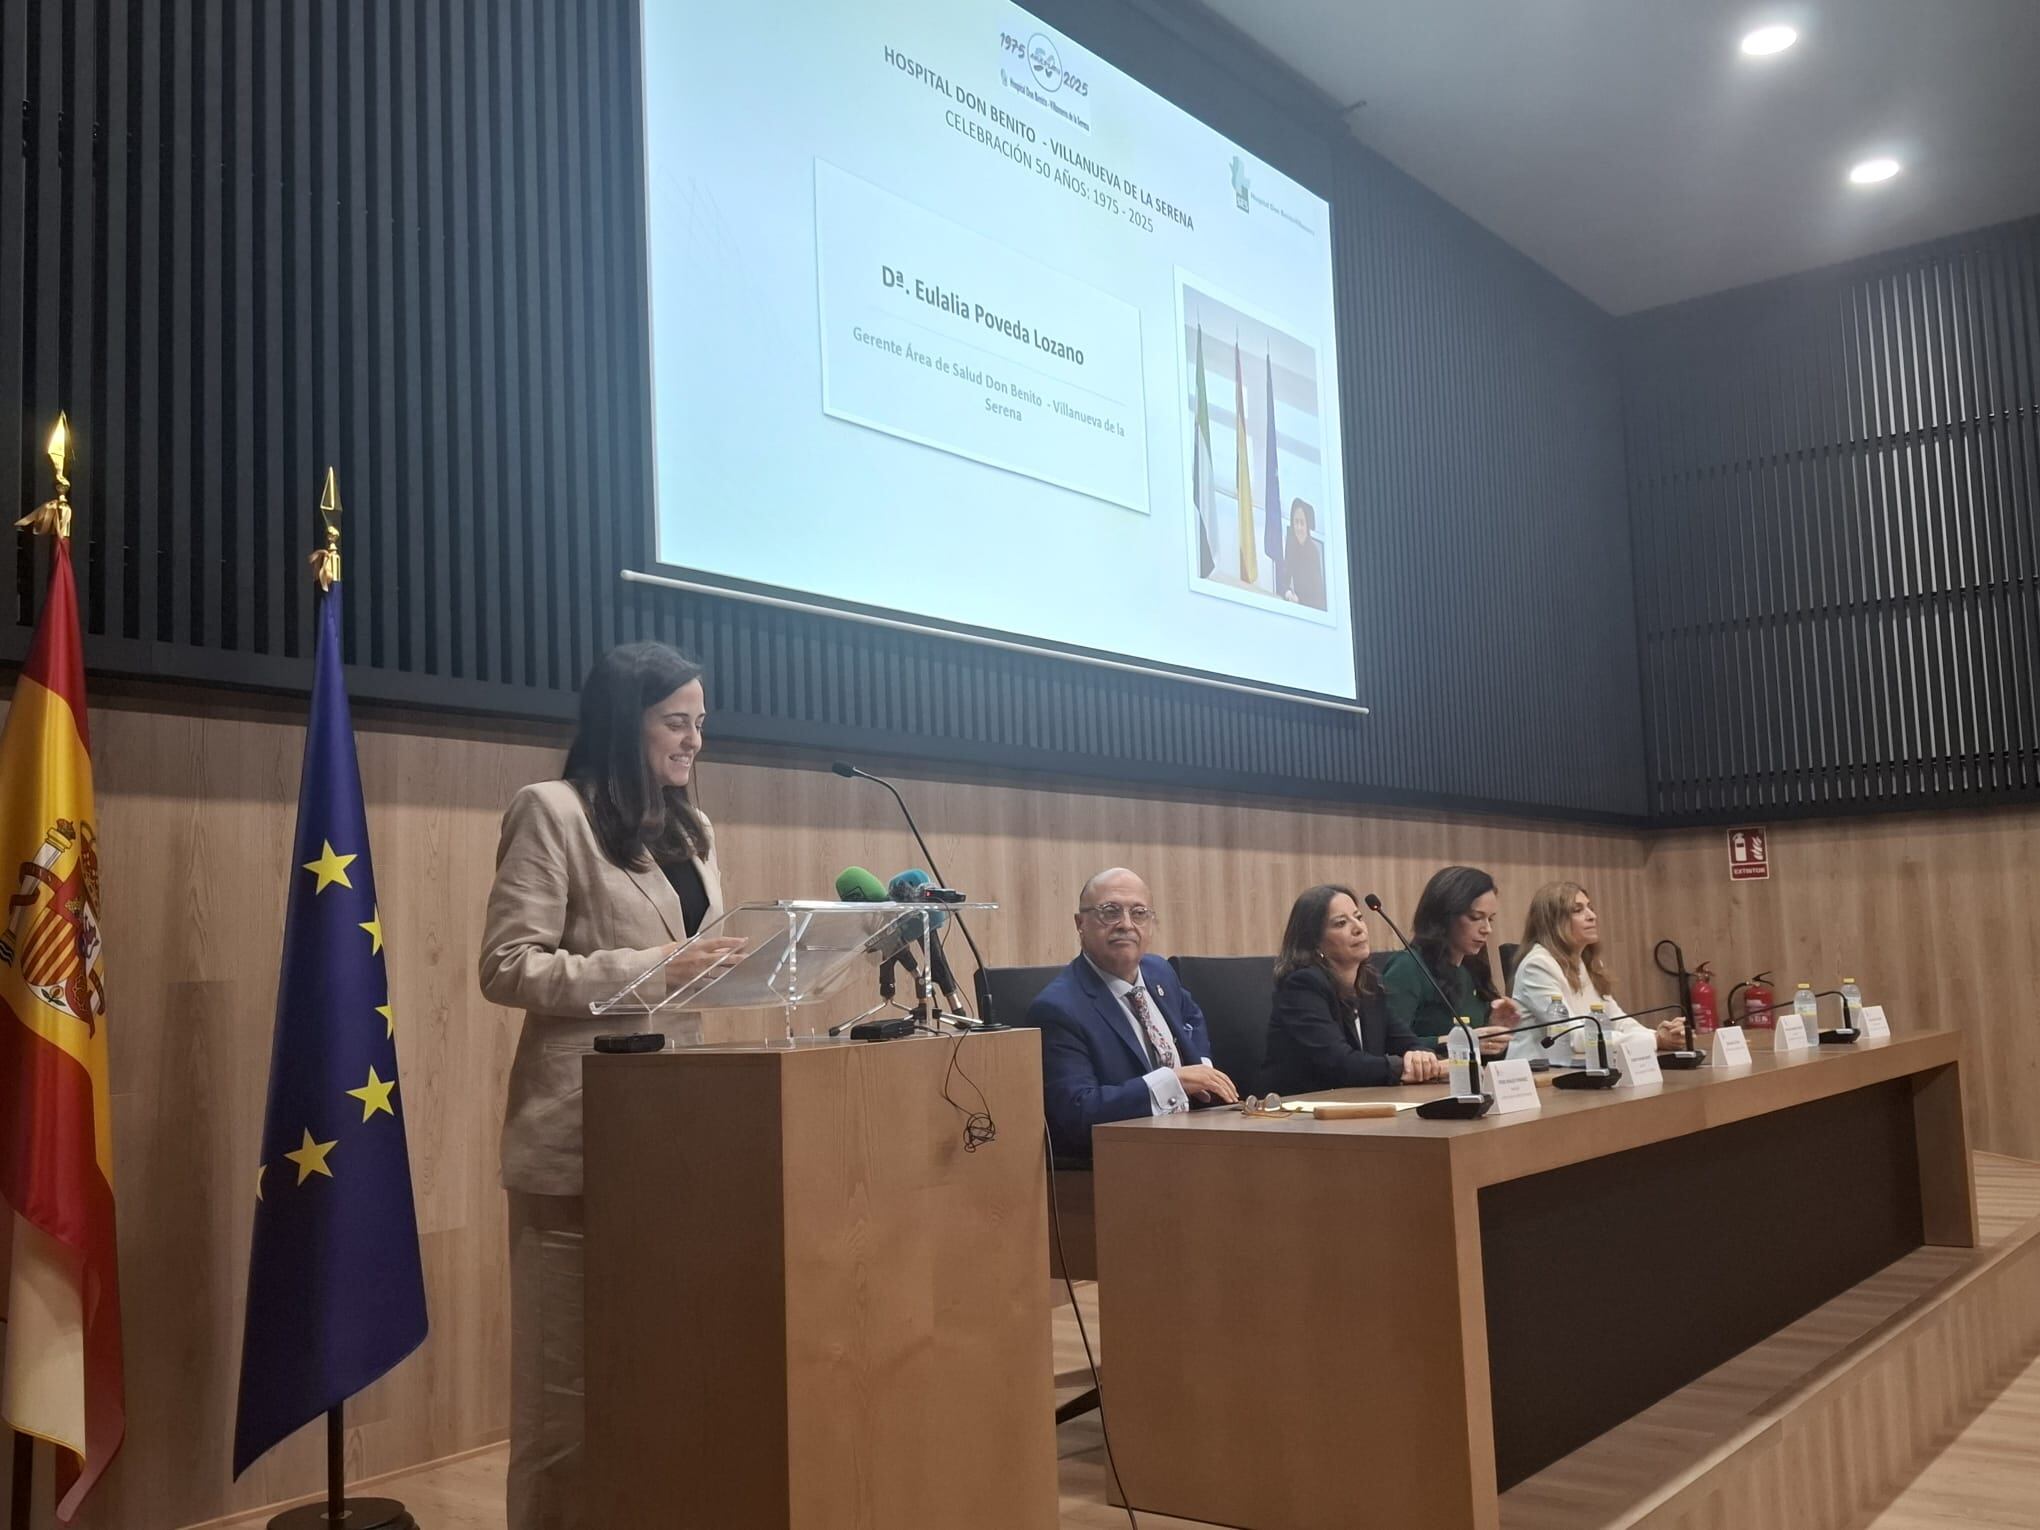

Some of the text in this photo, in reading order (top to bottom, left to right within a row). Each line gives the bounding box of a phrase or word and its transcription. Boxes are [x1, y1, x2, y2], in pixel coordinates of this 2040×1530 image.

[1000, 32, 1025, 59] 1975
[1063, 71, 1088, 96] 2025
[884, 45, 952, 98] HOSPITAL
[956, 86, 986, 116] DON
[991, 105, 1036, 143] BENITO
[1050, 137, 1121, 191] VILLANUEVA
[1124, 180, 1138, 200] DE
[1140, 189, 1153, 209] LA
[1155, 198, 1194, 231] SERENA
[945, 110, 1032, 170] CELEBRACIÓN
[1035, 158, 1051, 178] 50
[1054, 168, 1090, 200] AÑOS:
[1093, 189, 1119, 215] 1975
[1128, 208, 1154, 233] 2025
[882, 265, 1084, 365] Dª. Eulalia Poveda Lozano
[853, 326, 902, 356] Gerente
[905, 342, 932, 367] Área
[935, 356, 950, 373] de
[952, 363, 982, 385] Salud
[985, 375, 1008, 395] Don
[1011, 383, 1042, 407] Benito
[1053, 400, 1101, 428] Villanueva
[1104, 419, 1115, 433] de
[1117, 423, 1124, 437] la
[985, 398, 1022, 422] Serena
